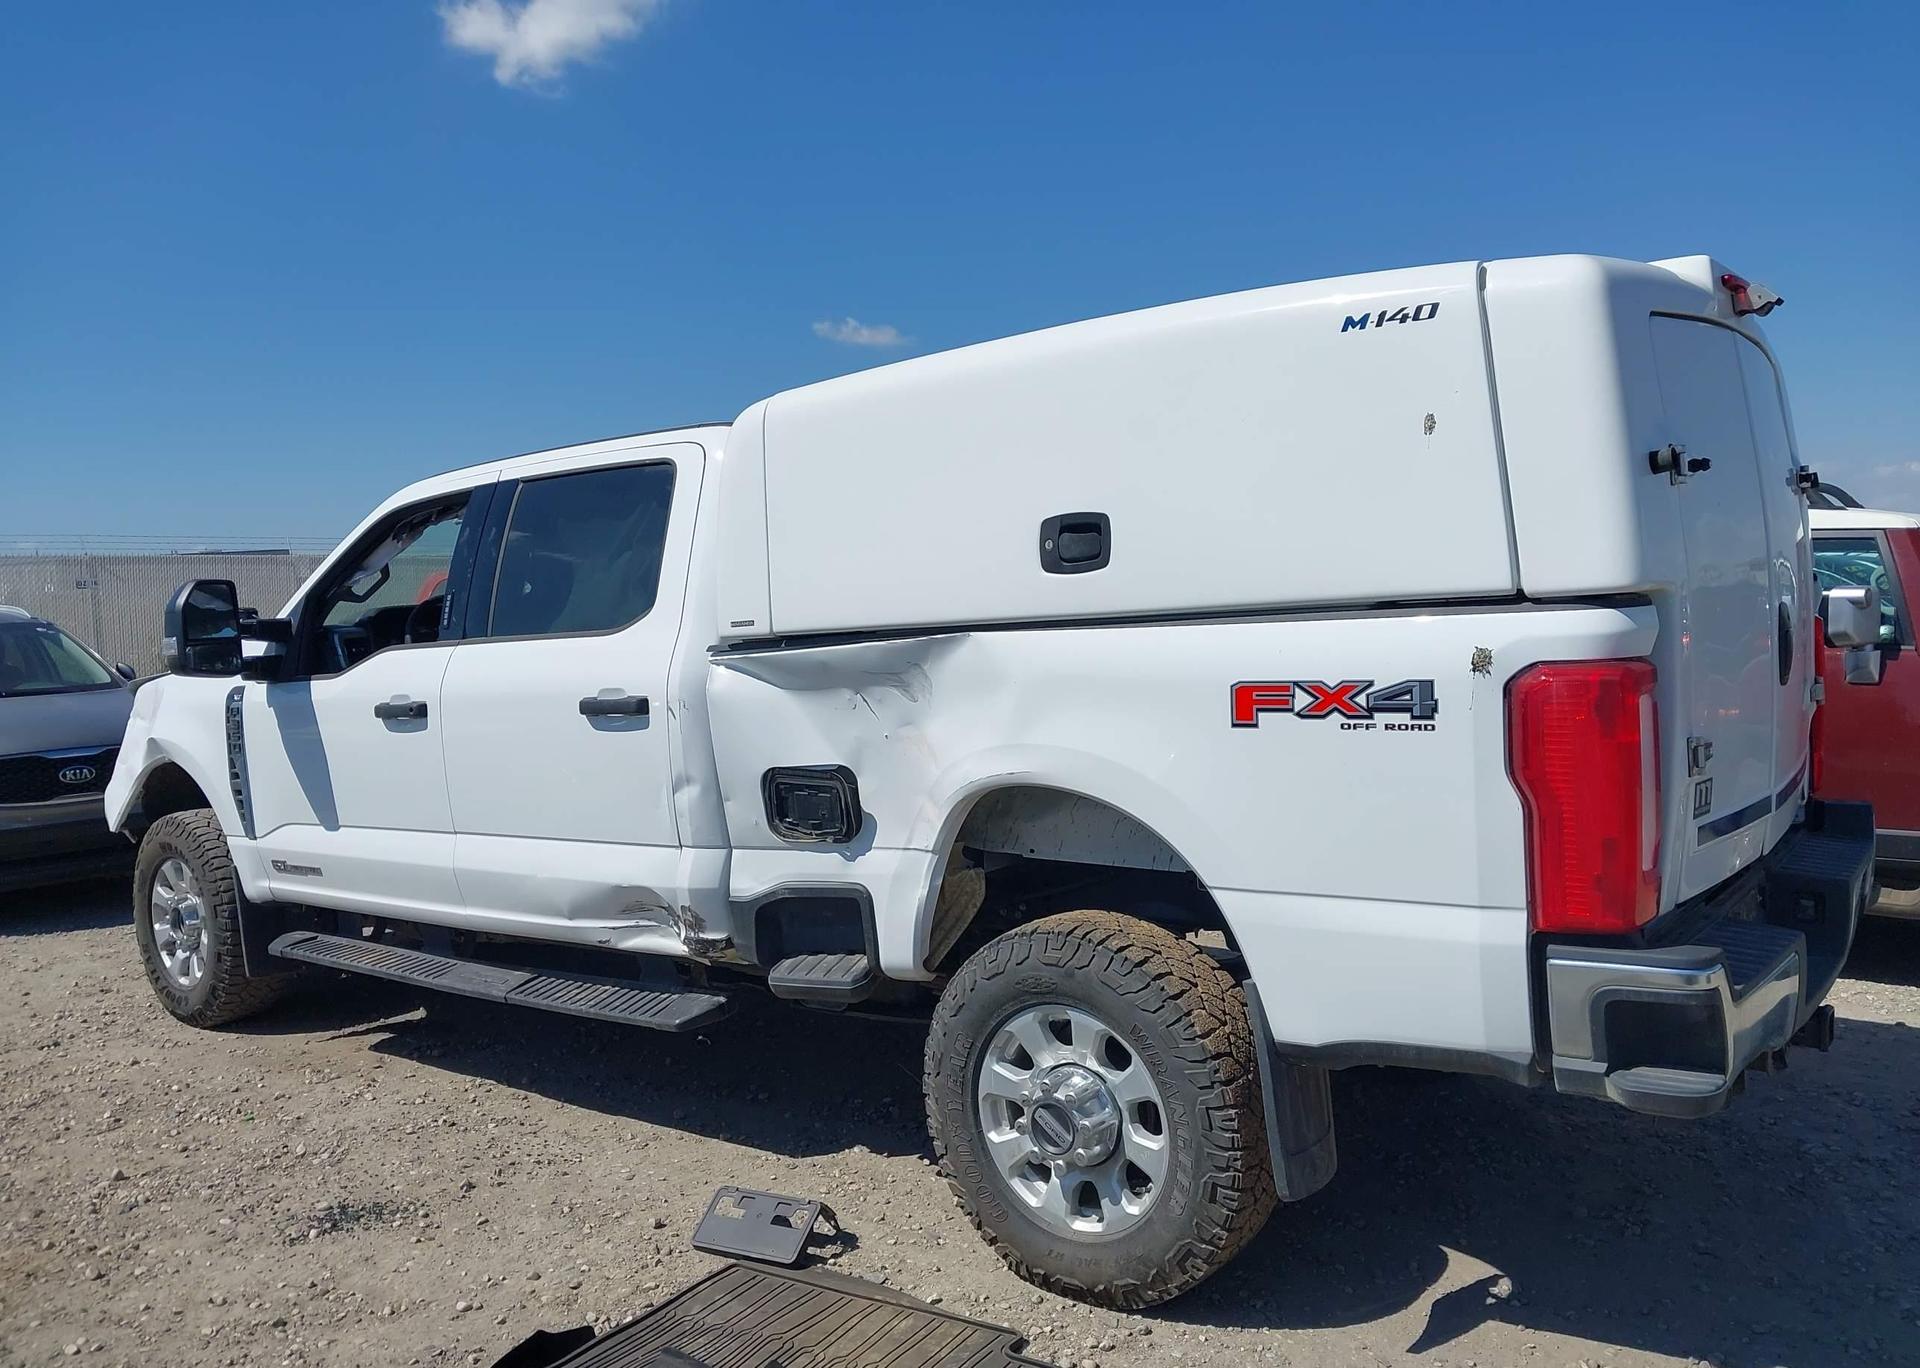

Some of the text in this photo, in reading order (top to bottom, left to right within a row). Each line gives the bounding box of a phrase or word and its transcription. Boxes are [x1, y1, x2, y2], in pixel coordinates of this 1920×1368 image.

[1341, 302, 1440, 332] M-140
[1231, 679, 1439, 728] FX4
[1340, 723, 1436, 732] OFF ROAD
[65, 768, 91, 780] KIA
[947, 1031, 1009, 1223] GOODYEAR
[1037, 1113, 1066, 1144] FORD
[1129, 1023, 1194, 1217] WRANGLER
